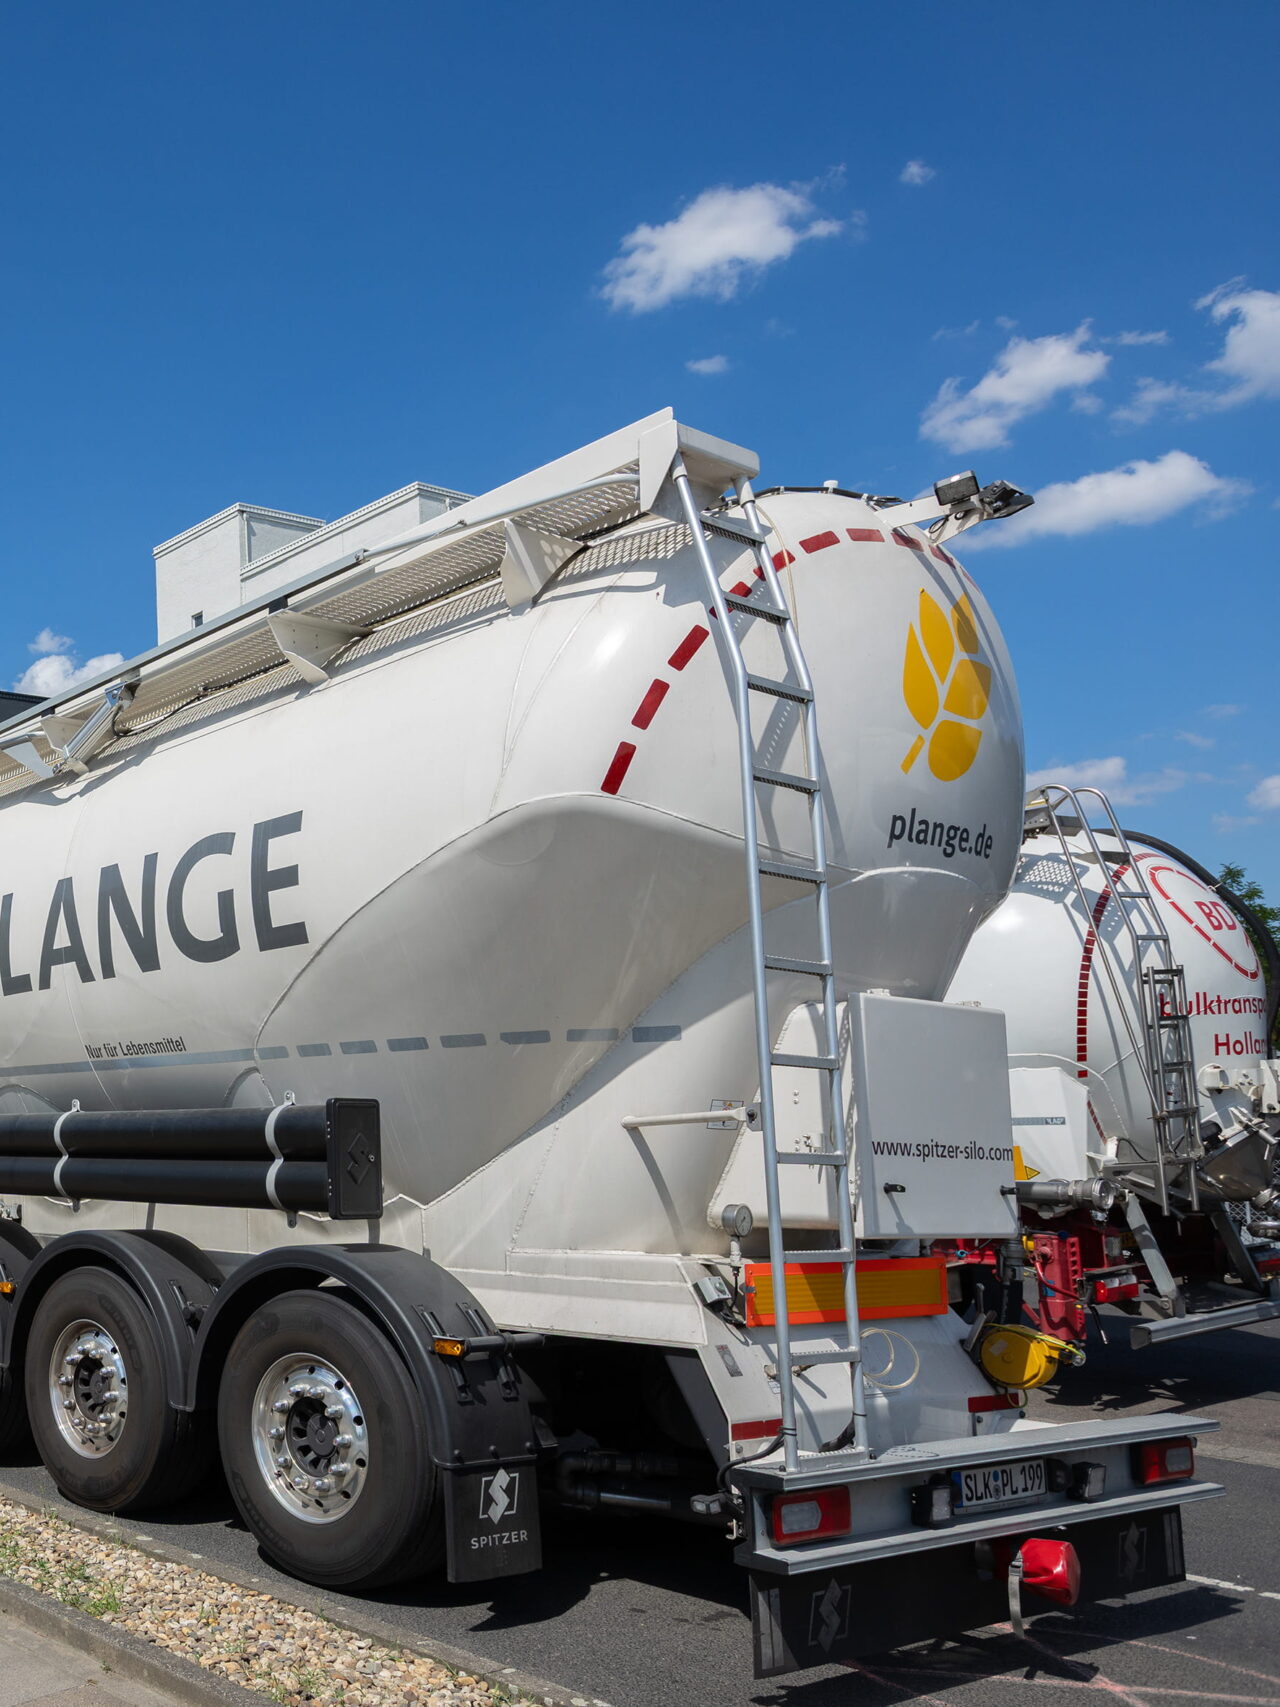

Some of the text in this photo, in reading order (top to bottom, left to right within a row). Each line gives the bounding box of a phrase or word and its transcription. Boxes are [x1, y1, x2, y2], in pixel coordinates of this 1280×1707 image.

[887, 807, 993, 860] plange.de
[1158, 991, 1266, 1020] bulktransp
[84, 1036, 187, 1059] Nur für Lebensmittel
[871, 1138, 1014, 1163] www.spitzer-silo.com
[964, 1463, 1044, 1502] SLK PL 199
[470, 1529, 529, 1549] SPITZER
